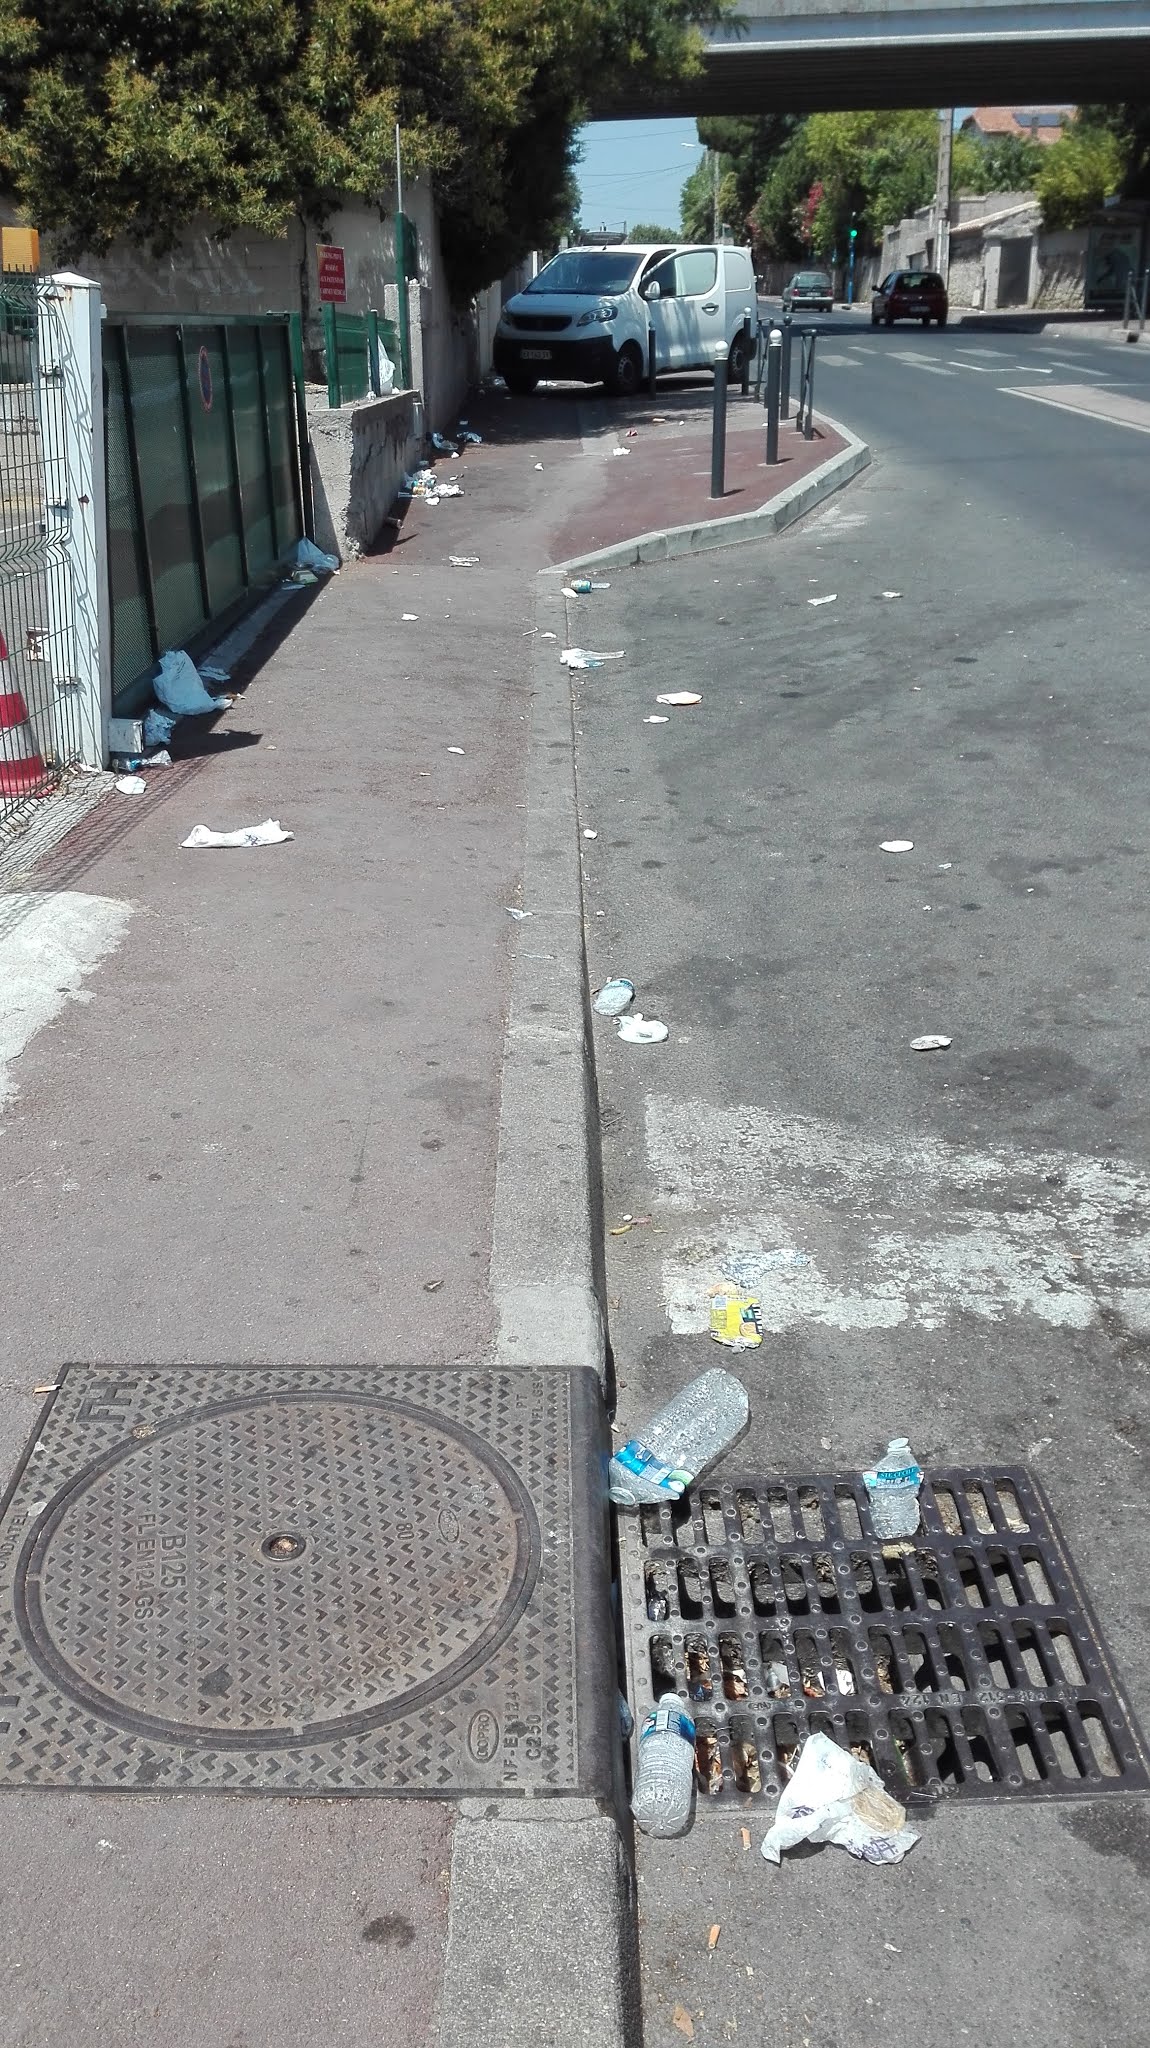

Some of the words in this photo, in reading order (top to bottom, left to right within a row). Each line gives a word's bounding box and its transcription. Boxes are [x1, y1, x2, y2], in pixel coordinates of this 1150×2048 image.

[137, 1513, 157, 1535] FL
[395, 1522, 415, 1541] 80
[160, 1534, 188, 1589] B125
[134, 1594, 155, 1621] GS
[525, 1714, 542, 1761] C250
